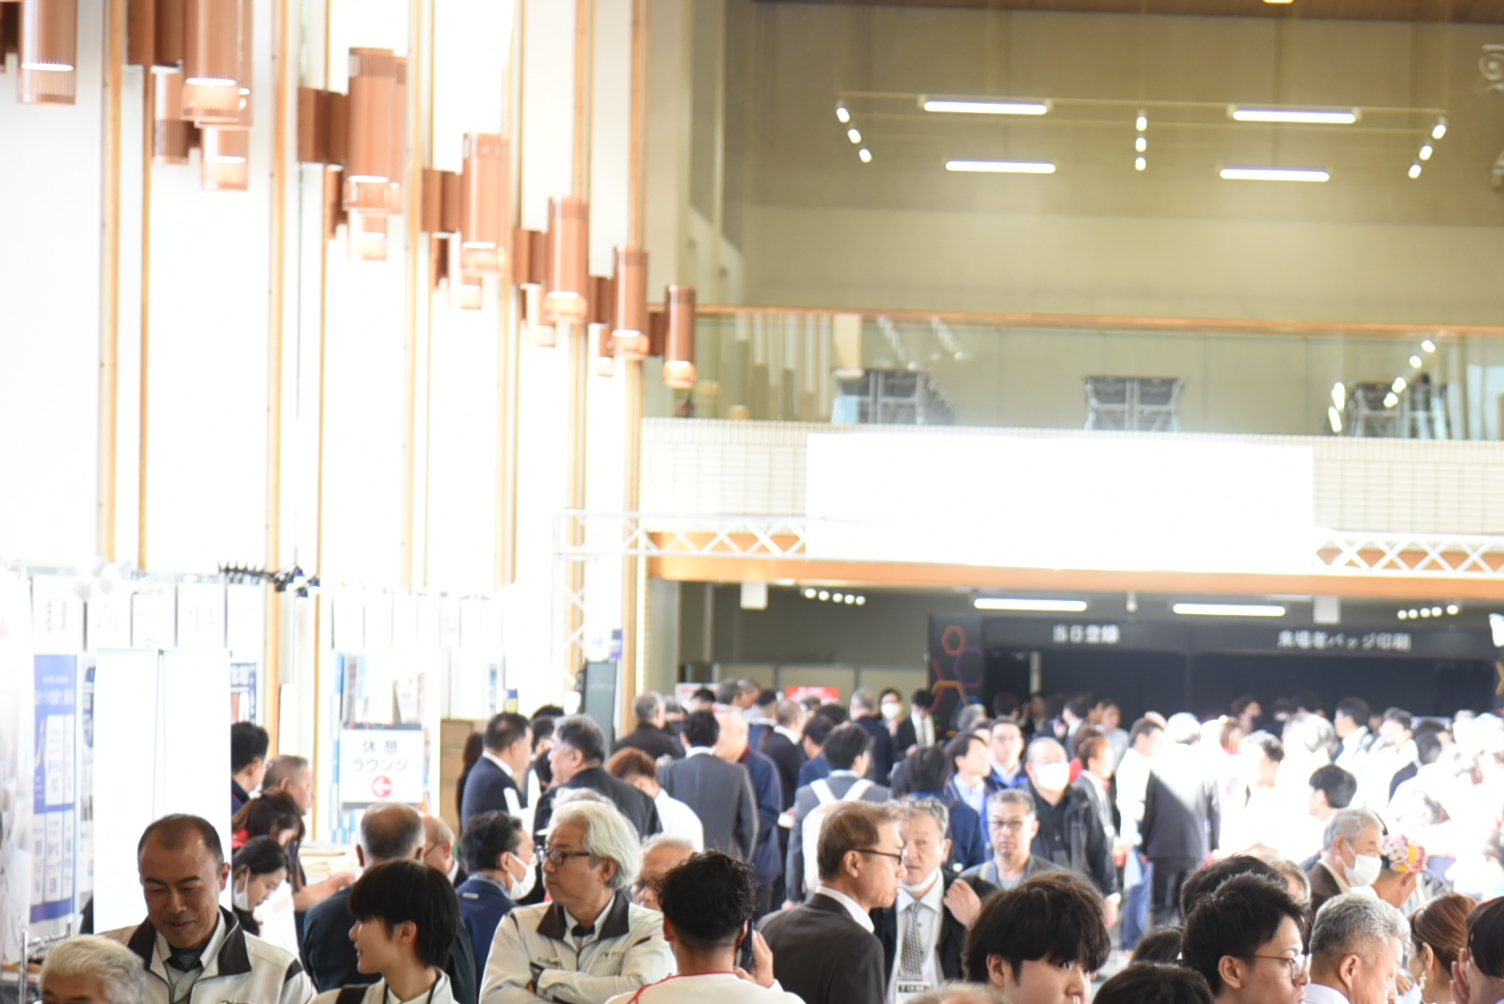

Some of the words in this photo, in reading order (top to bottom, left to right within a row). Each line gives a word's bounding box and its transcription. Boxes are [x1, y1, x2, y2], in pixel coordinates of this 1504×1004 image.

[1053, 624, 1120, 644] 当日登録
[1278, 630, 1411, 650] 来場者バッジ印刷
[363, 739, 397, 755] 休憩
[353, 757, 408, 772] ラウンジ
